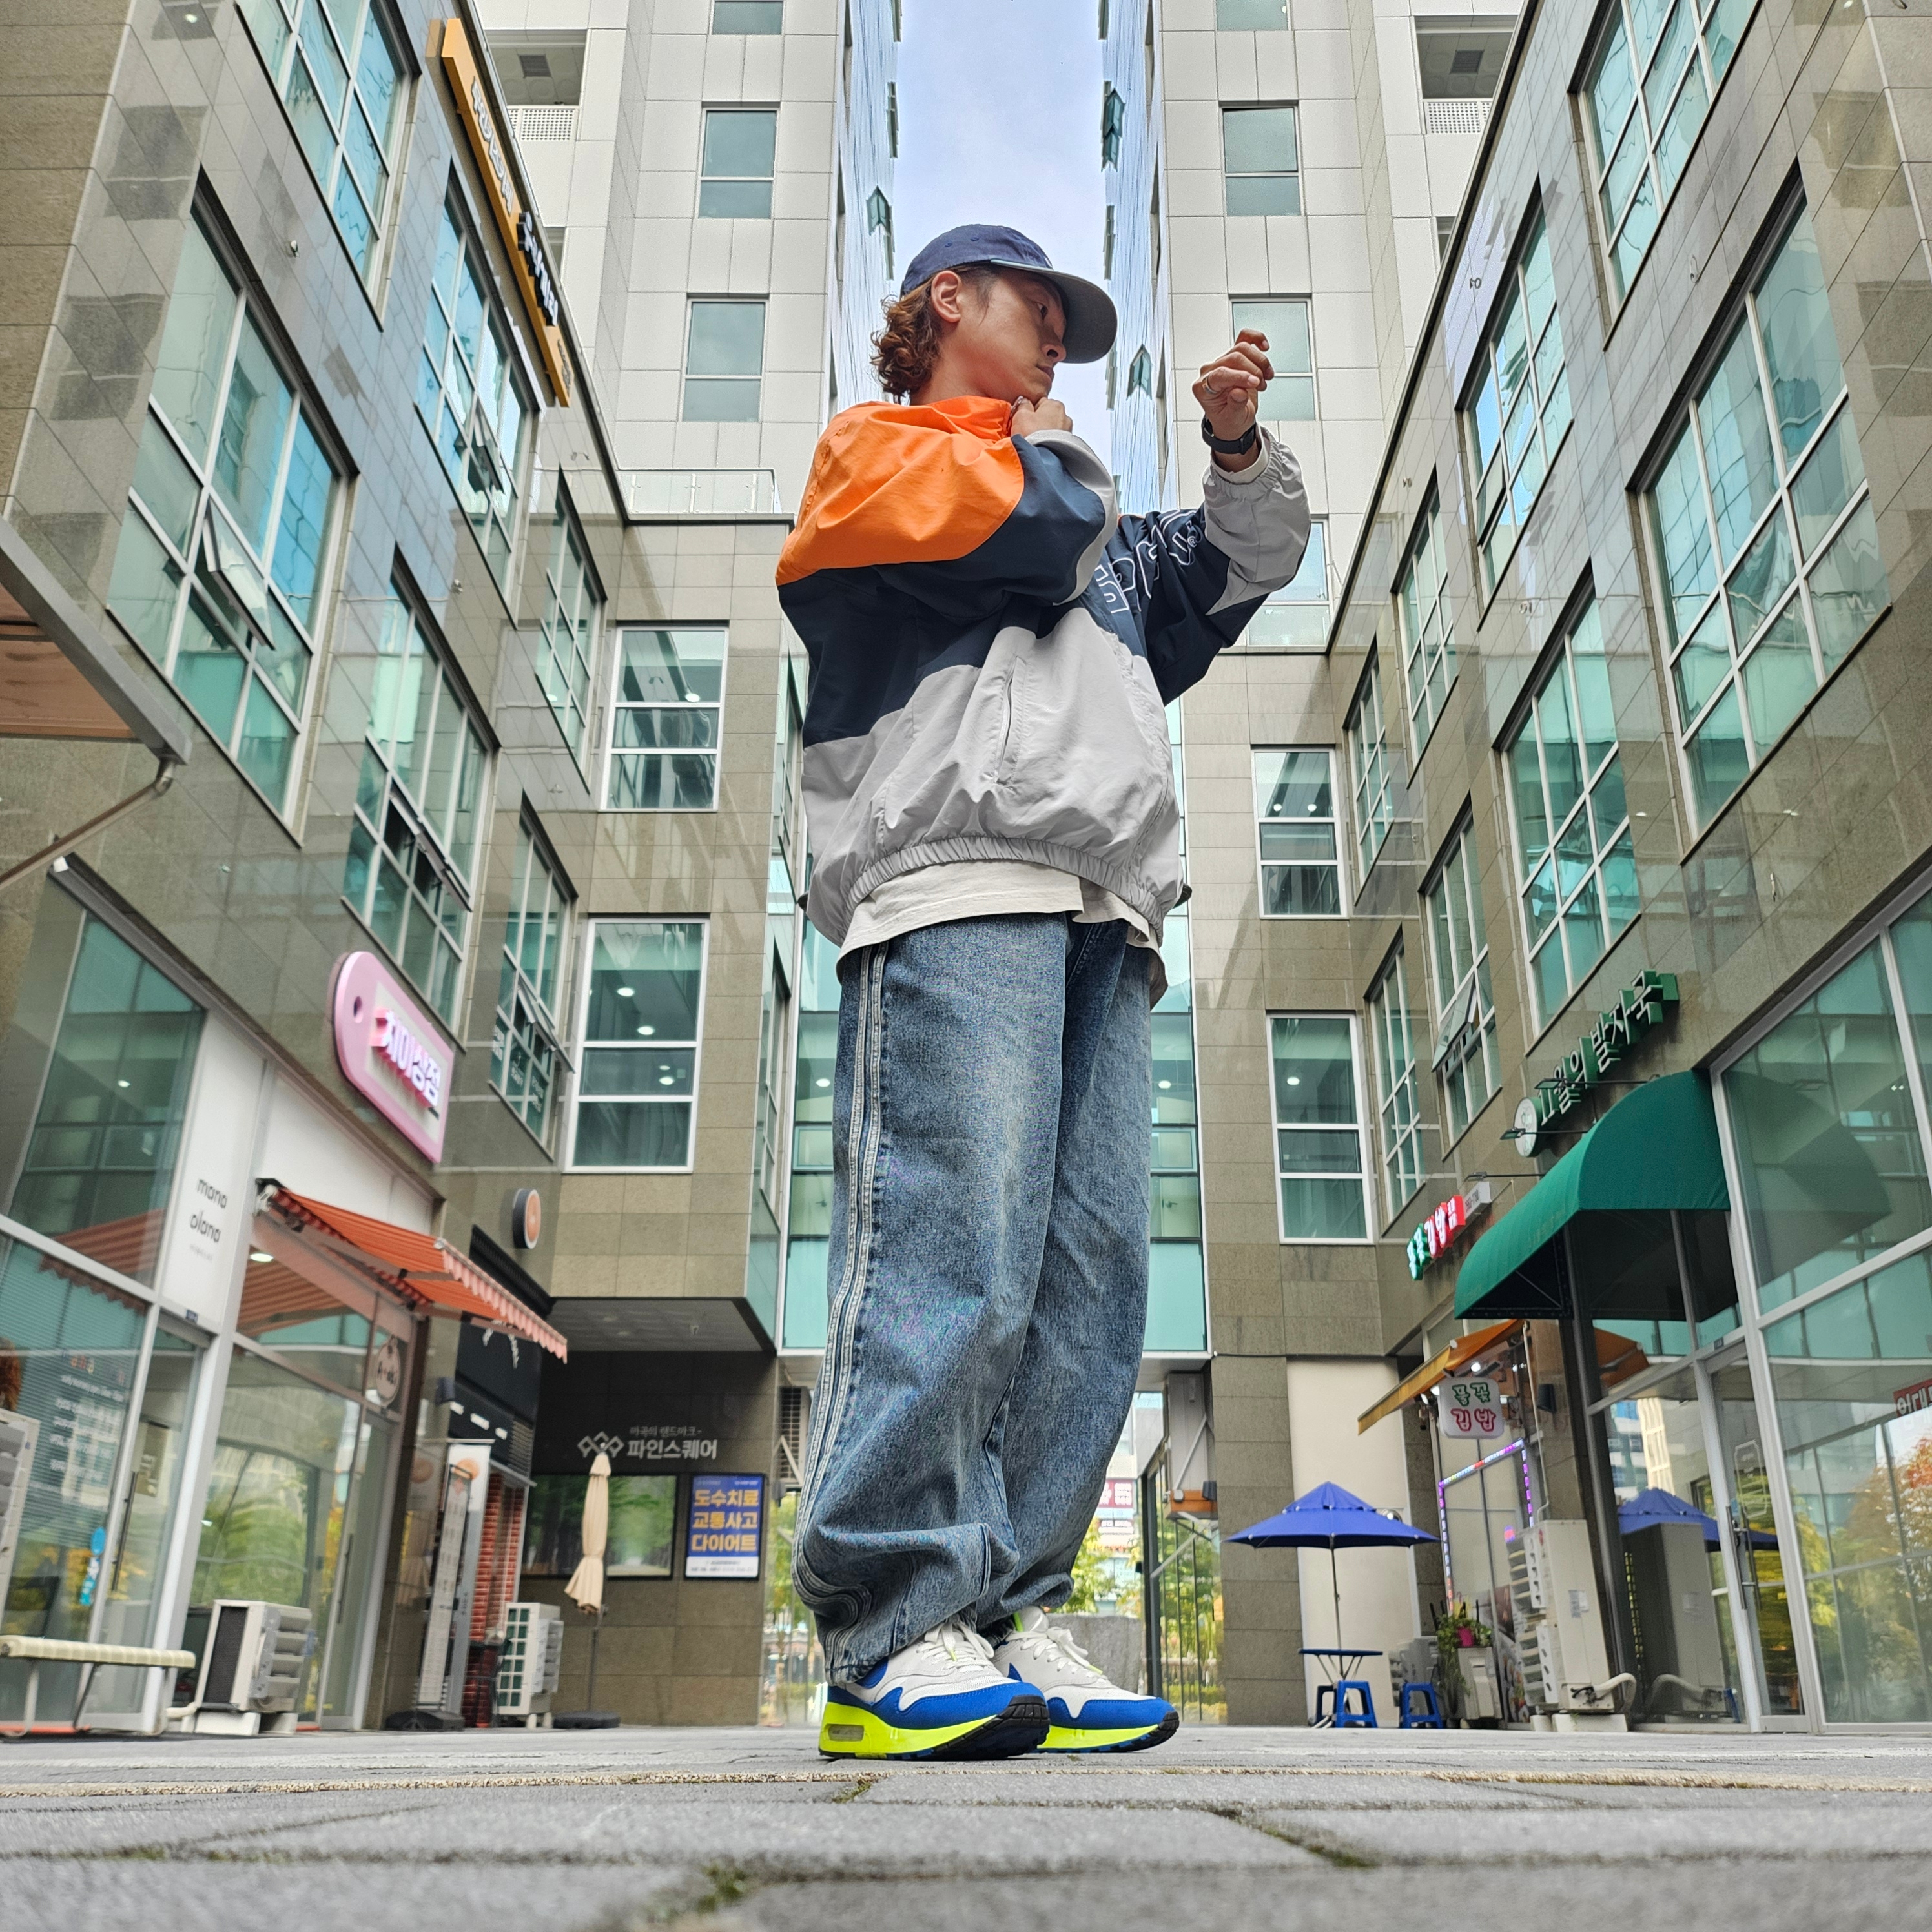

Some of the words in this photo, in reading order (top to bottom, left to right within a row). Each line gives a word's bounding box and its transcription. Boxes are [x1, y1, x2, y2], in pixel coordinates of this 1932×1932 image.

[1452, 1382, 1491, 1406] 풀꽃
[1450, 1408, 1496, 1432] 김밥
[627, 1439, 718, 1460] 파인스퀘어
[694, 1489, 759, 1508] 도수치료
[692, 1511, 758, 1530] 교통사고
[691, 1534, 757, 1552] 다이어트
